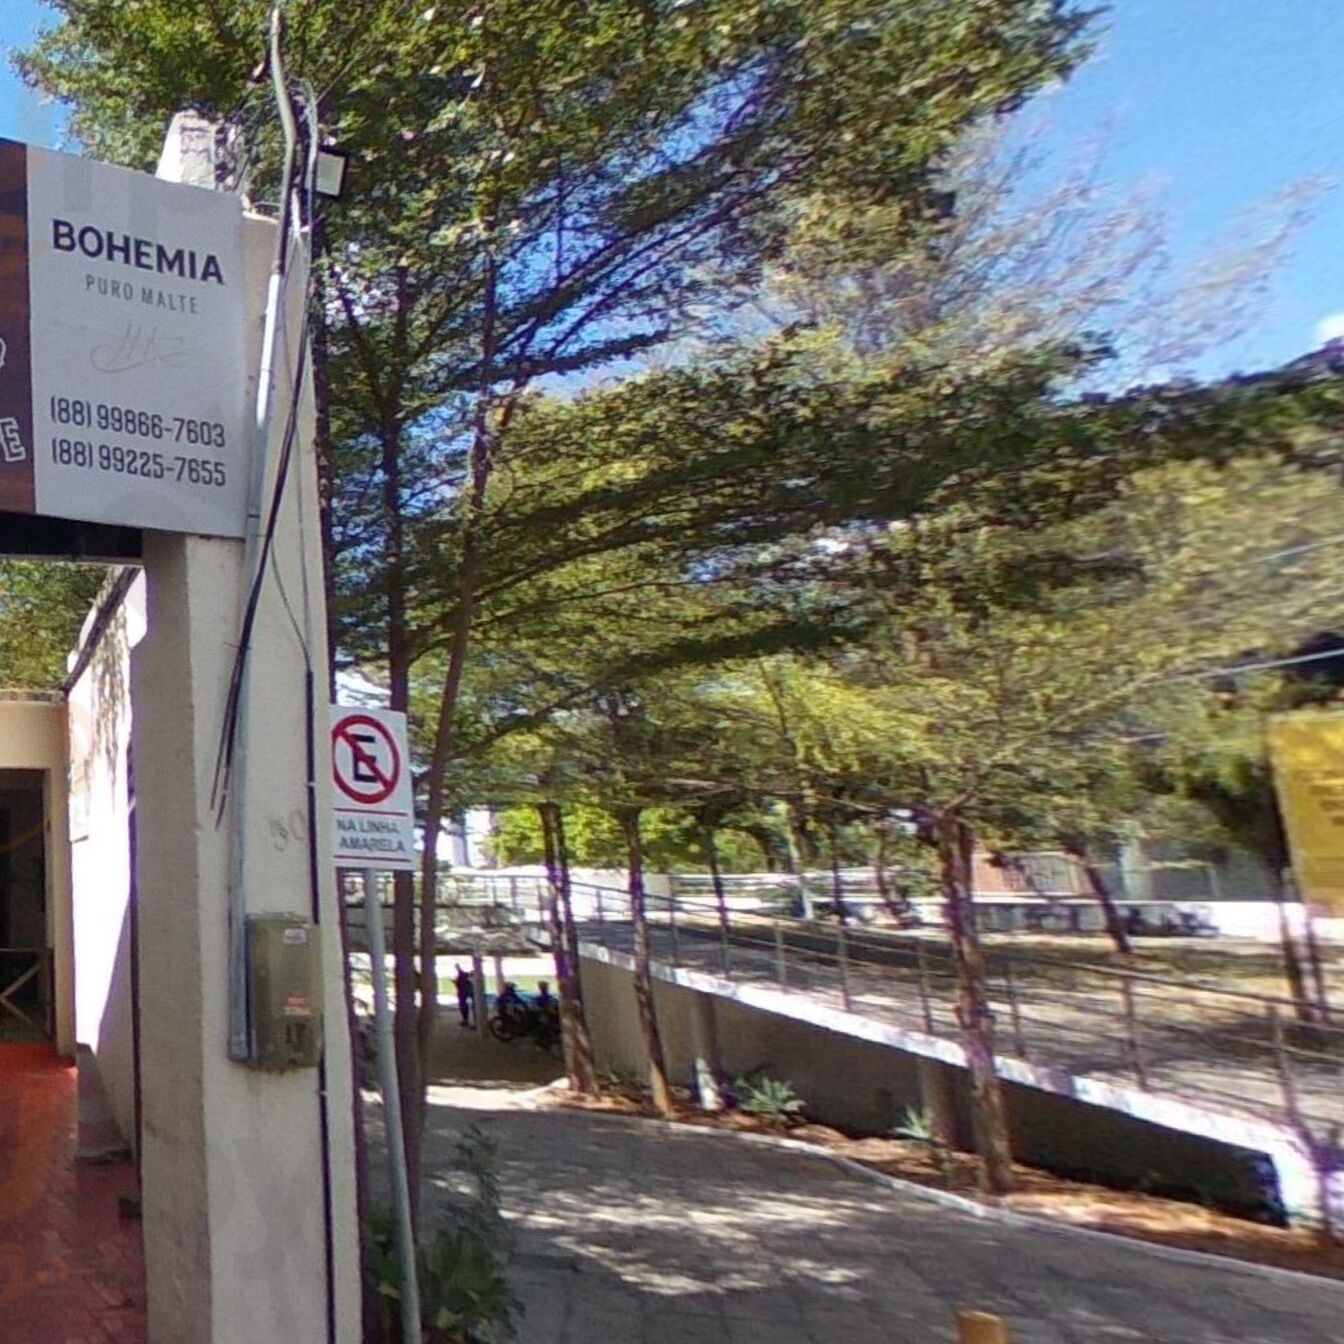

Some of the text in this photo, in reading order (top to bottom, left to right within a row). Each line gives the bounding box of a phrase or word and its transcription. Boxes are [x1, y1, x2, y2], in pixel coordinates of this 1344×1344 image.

[53, 219, 225, 286] BOHEMIA
[85, 273, 200, 315] PURO MALTE
[51, 396, 226, 448] (88) 99866-7603
[52, 438, 227, 487] (88) 99225-7655
[336, 818, 401, 835] NA LINHA
[340, 836, 406, 853] AMARELA
